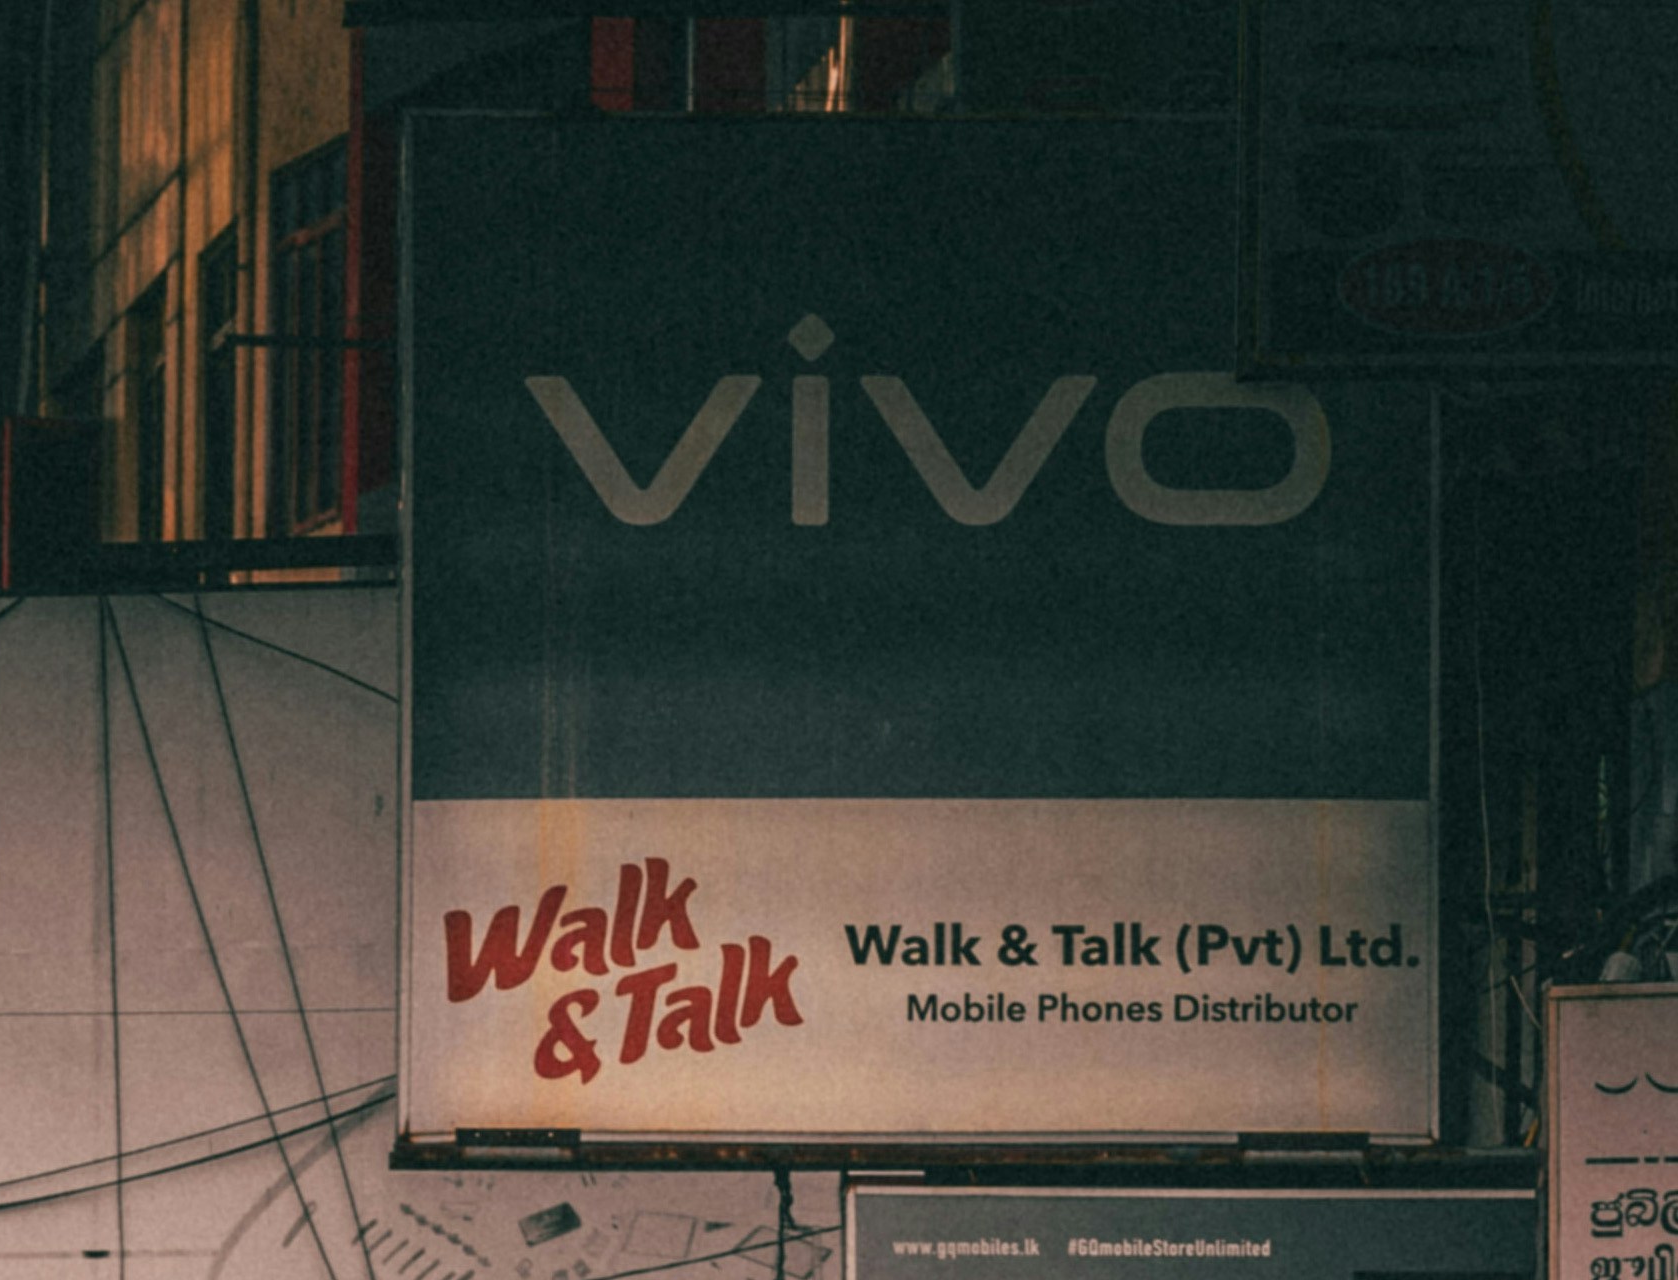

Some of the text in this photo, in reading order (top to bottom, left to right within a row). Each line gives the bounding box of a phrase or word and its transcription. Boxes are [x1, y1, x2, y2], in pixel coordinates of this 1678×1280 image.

[523, 312, 1333, 527] vivo
[445, 855, 701, 1004] Walk
[845, 919, 1421, 976] Walk & Talk (Pvt) Ltd.
[532, 934, 805, 1085] & Talk
[904, 993, 1359, 1025] Mobile Phones Distributor
[893, 1237, 1272, 1260] www.gqmobiles.lk #GQmobileStoreUnlimited
